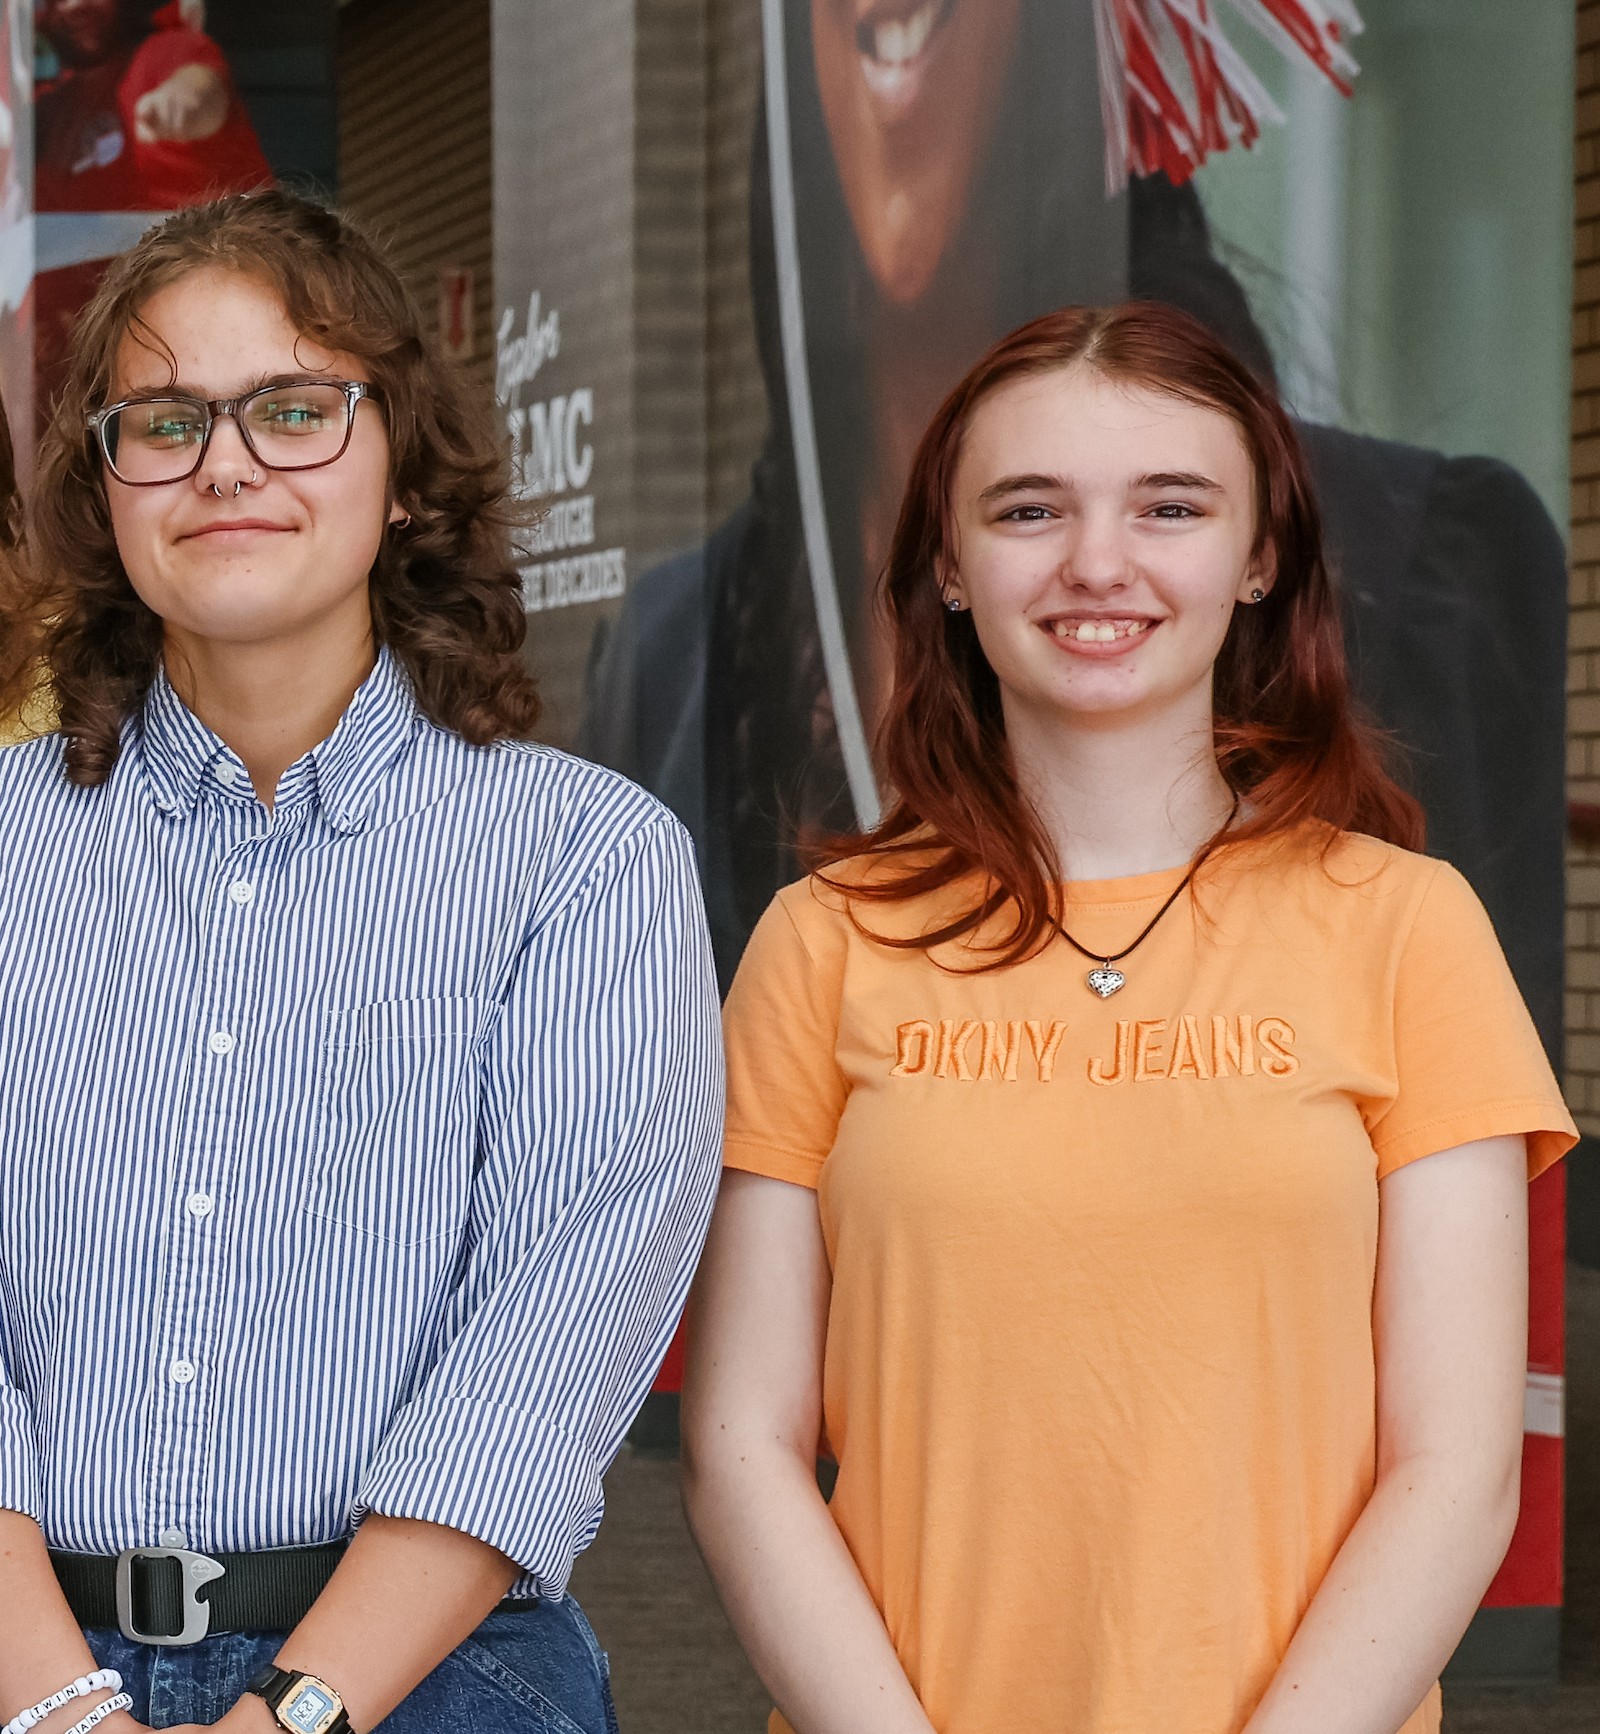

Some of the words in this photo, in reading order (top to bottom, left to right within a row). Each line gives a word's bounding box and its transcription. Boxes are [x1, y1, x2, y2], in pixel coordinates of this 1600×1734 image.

[890, 1019, 1068, 1083] DKNY
[1087, 1014, 1300, 1086] JEANS
[33, 1687, 75, 1715] TWIN
